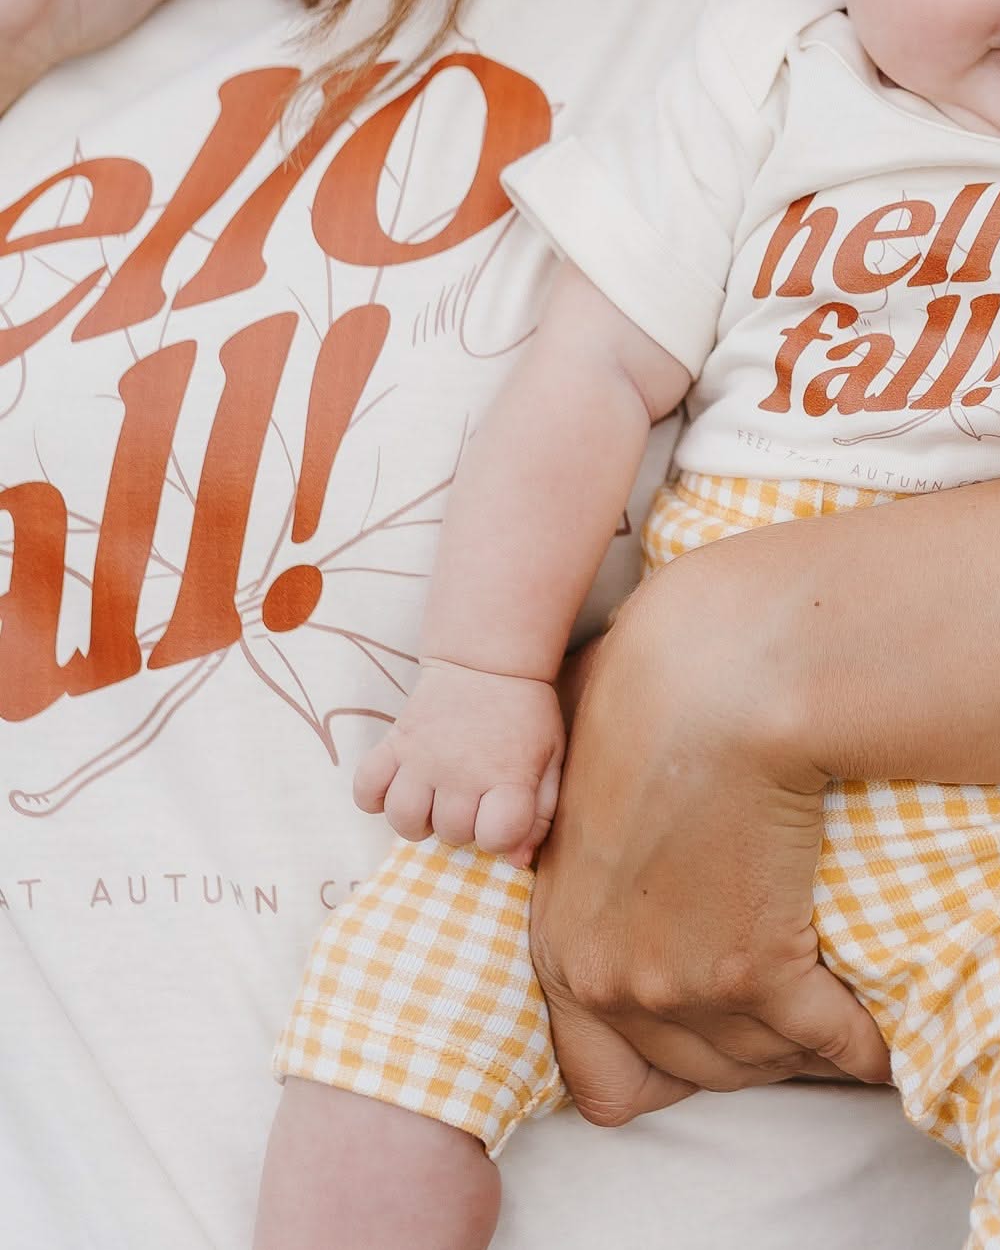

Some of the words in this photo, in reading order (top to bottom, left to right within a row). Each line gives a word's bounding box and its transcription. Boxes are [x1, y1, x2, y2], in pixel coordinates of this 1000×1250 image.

[0, 53, 552, 366] ello
[0, 304, 391, 722] all!
[850, 463, 944, 491] AUTUMN
